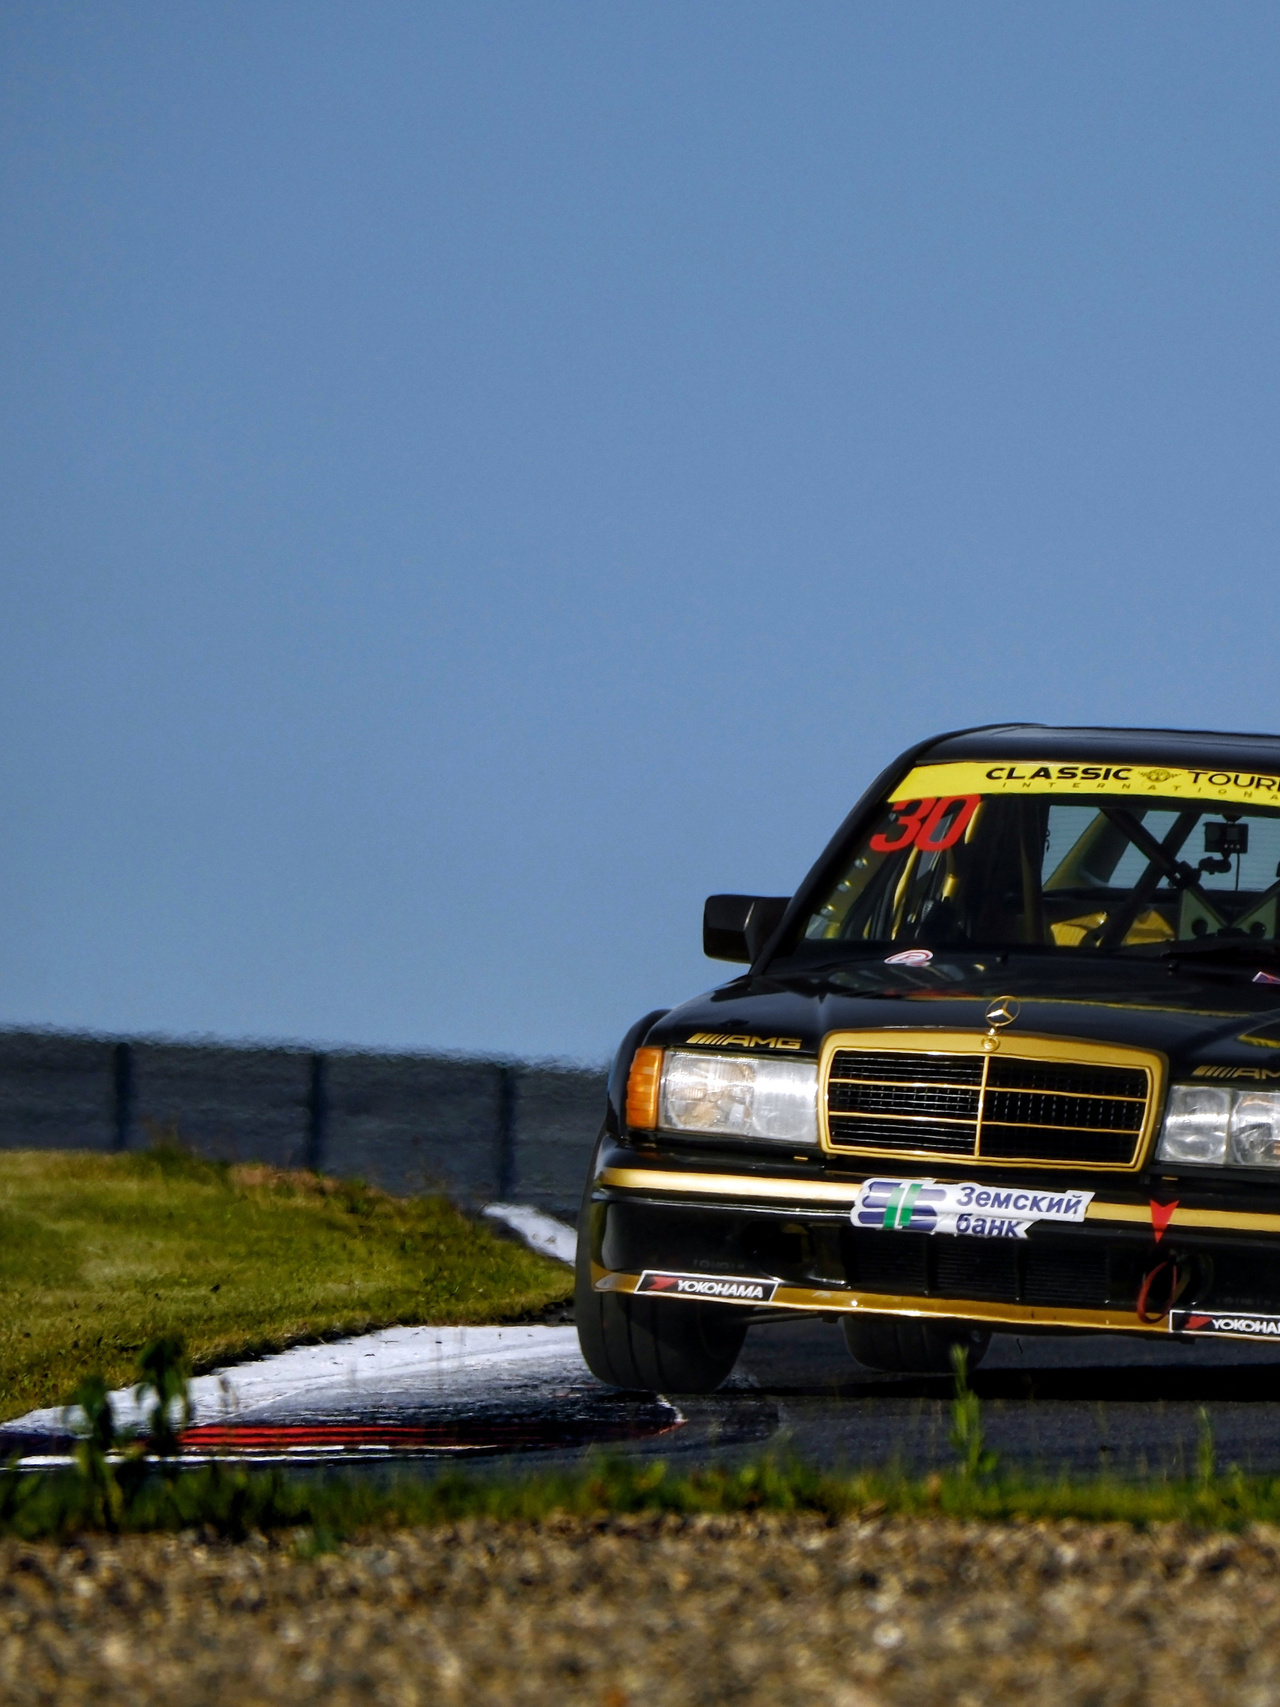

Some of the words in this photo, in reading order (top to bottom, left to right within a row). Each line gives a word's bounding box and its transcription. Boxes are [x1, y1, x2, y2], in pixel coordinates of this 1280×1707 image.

[986, 766, 1132, 782] CLASSIC
[870, 794, 981, 852] 30
[722, 1035, 801, 1051] AMG
[956, 1185, 1082, 1215] Земский
[955, 1212, 1025, 1239] банк
[676, 1280, 764, 1299] YOKOHAMA
